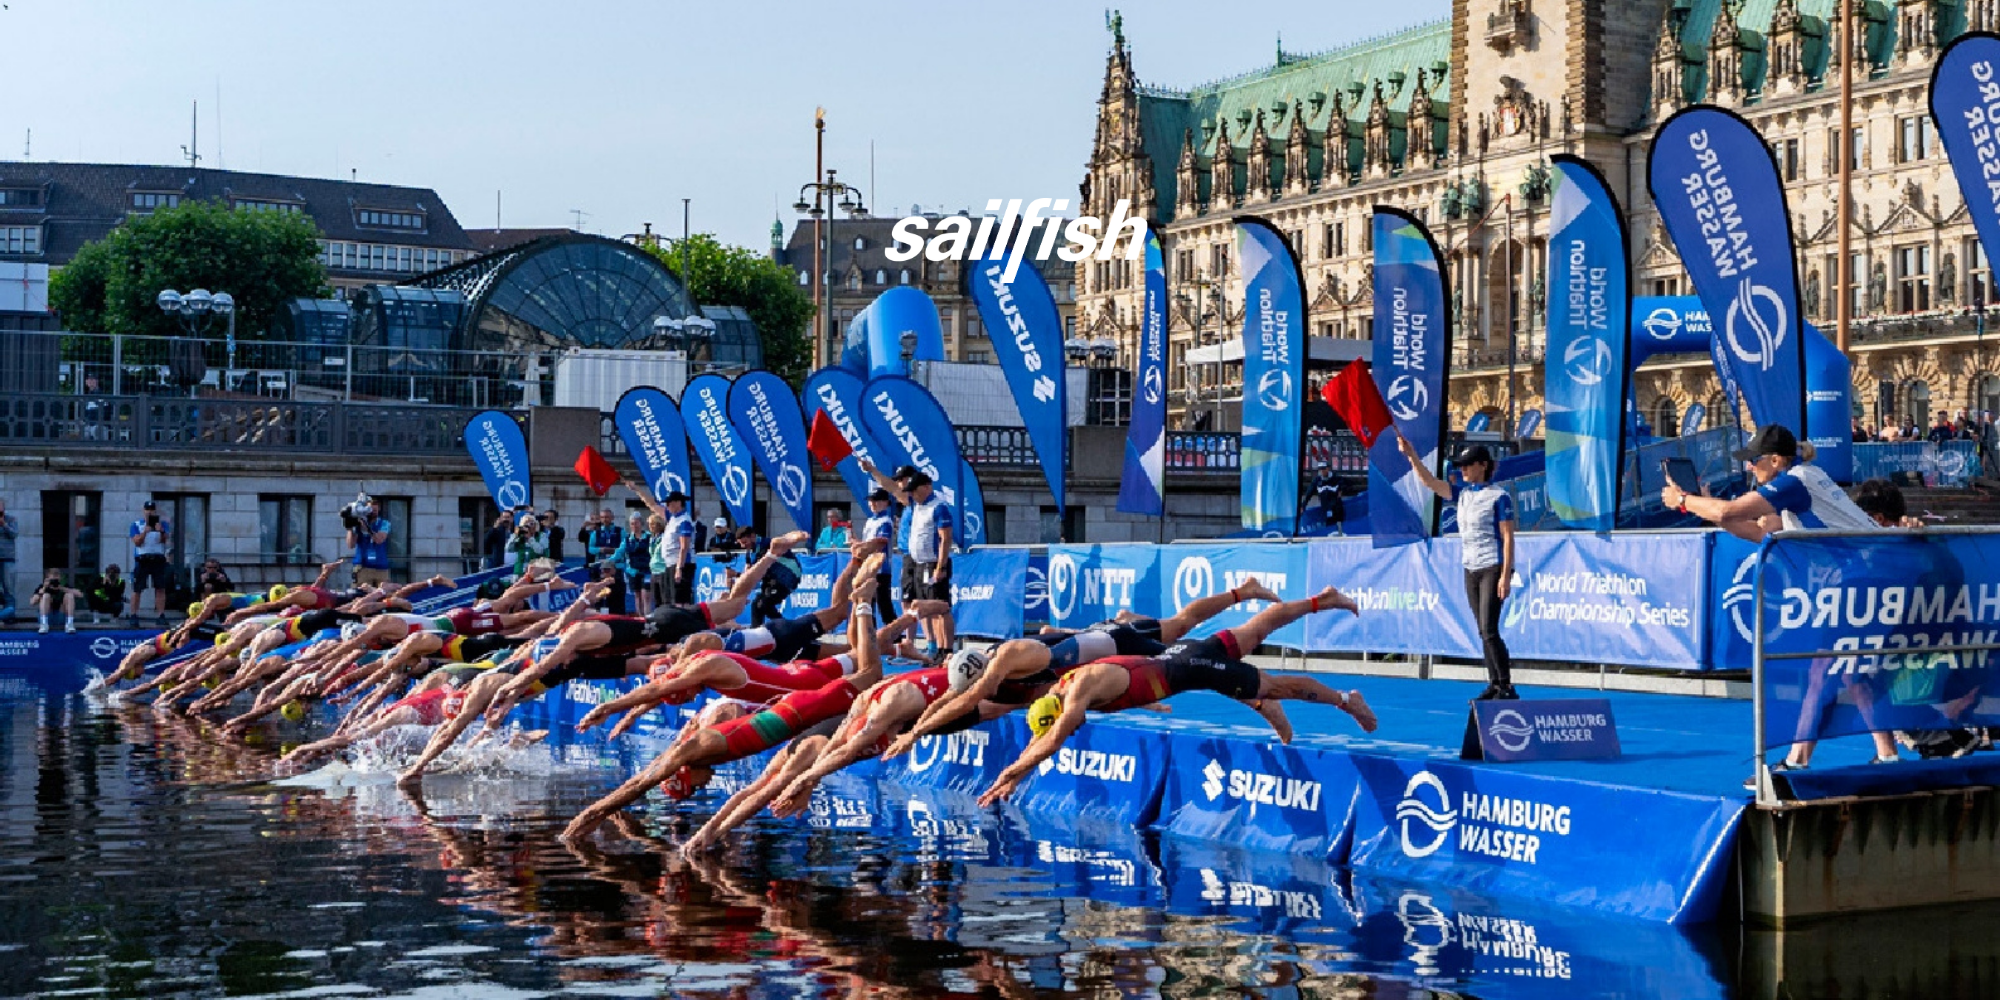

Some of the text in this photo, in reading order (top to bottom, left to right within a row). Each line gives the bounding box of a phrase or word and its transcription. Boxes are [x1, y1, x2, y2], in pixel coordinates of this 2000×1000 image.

[797, 573, 829, 589] AMBURG
[1083, 568, 1136, 606] NTT
[1535, 572, 1647, 596] World Triathlon
[1530, 597, 1690, 629] Championship Series
[958, 653, 984, 680] 20
[1534, 714, 1607, 729] HAMBURG
[1538, 729, 1594, 743] WASSER
[943, 730, 990, 767] NTT
[1055, 748, 1136, 783] SUZUKI
[1227, 769, 1322, 812] SUZUKI
[1462, 791, 1571, 836] HAMBURG
[1459, 823, 1541, 865] WASSER
